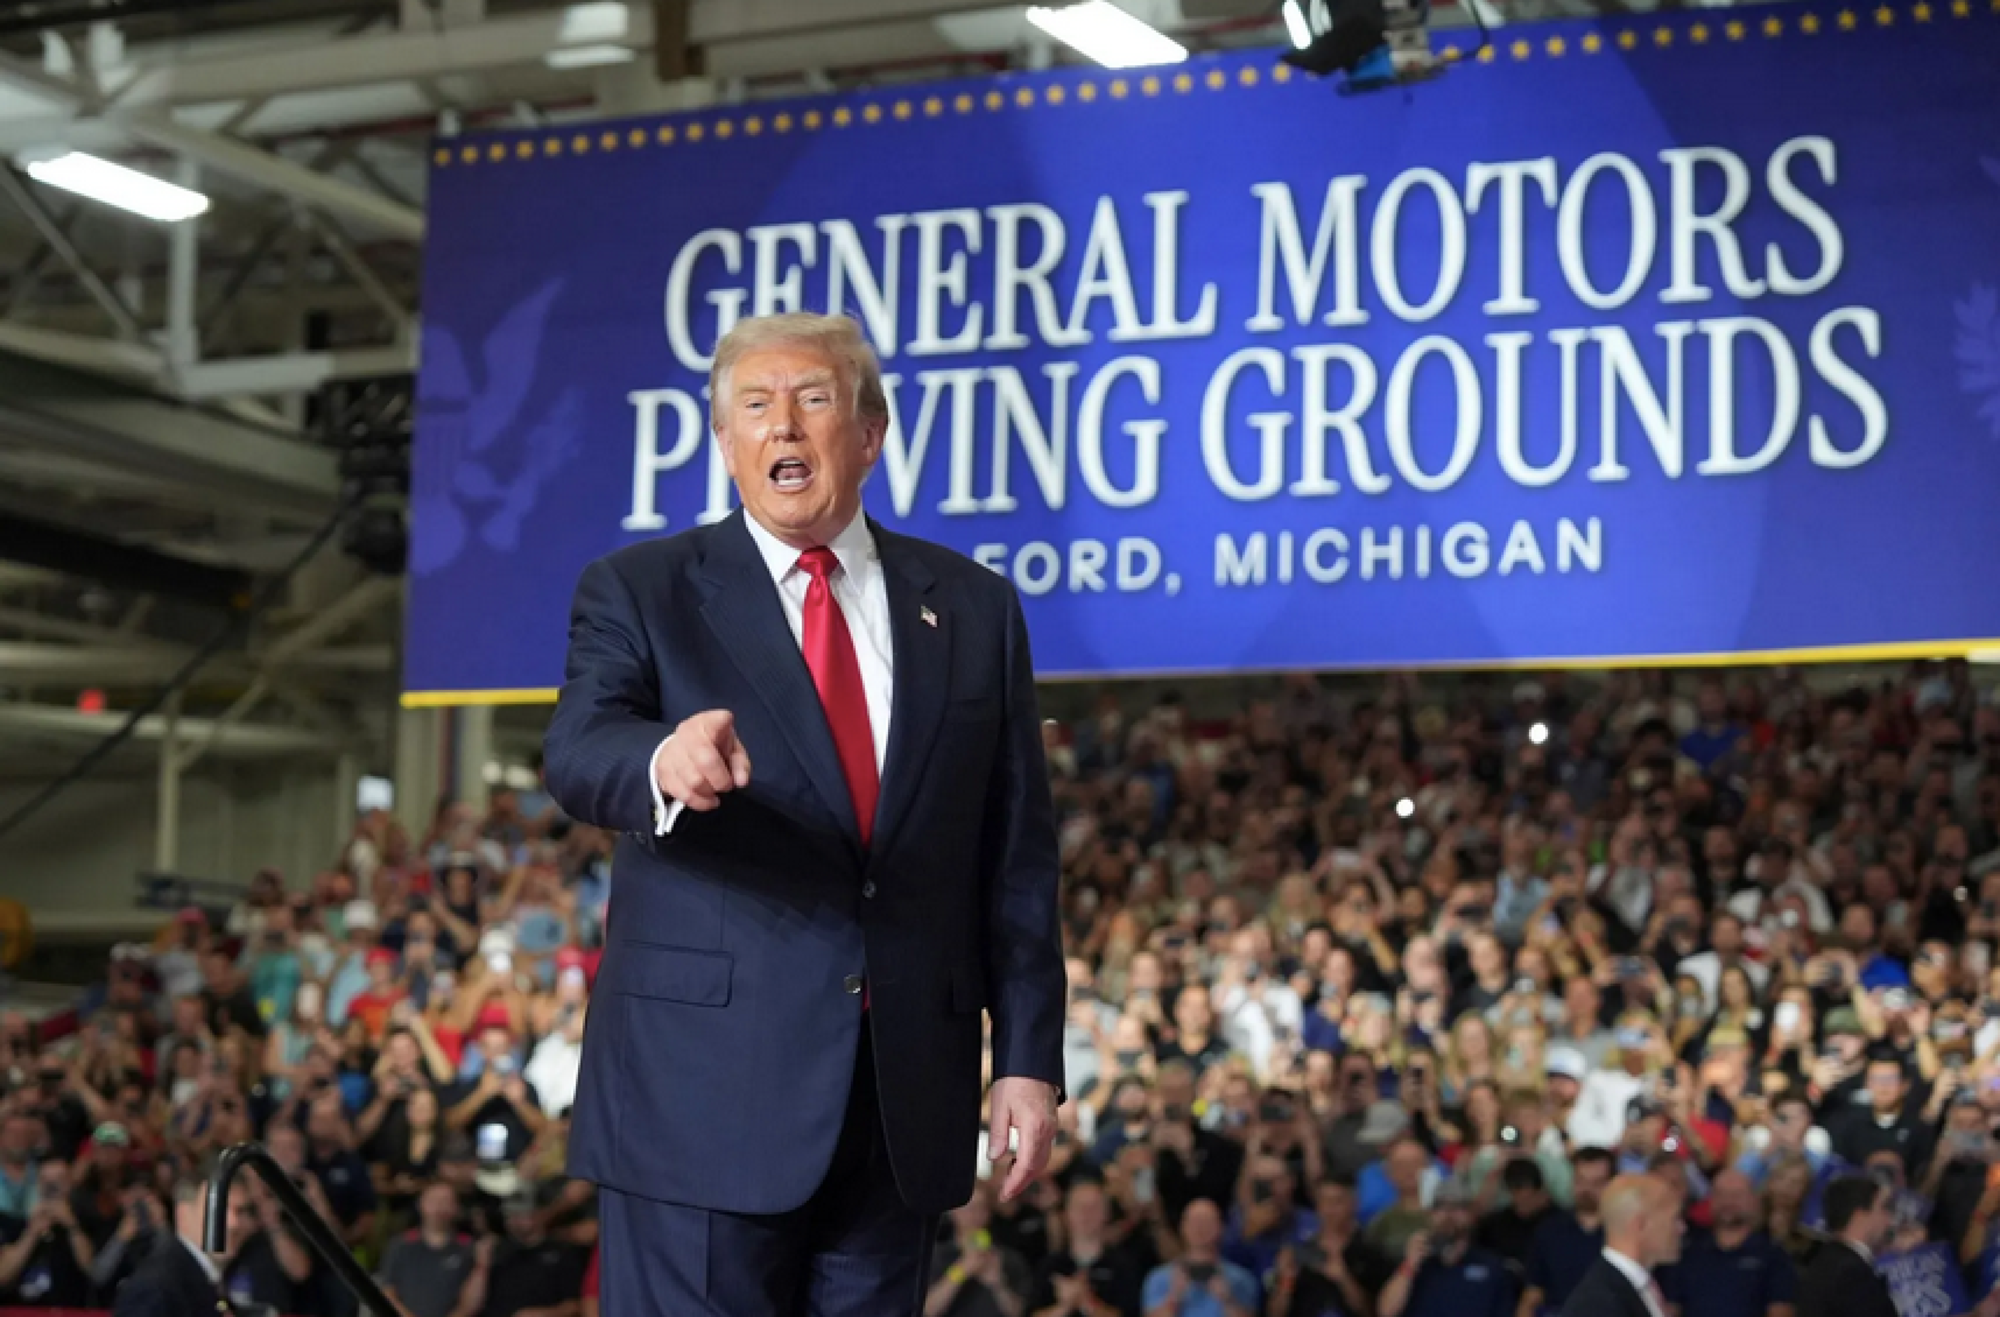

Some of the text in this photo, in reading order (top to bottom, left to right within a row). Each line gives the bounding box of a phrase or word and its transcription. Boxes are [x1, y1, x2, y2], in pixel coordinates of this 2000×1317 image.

[664, 136, 1843, 372] GENERAL MOTORS
[620, 306, 1888, 531] PVING GROUNDS
[1213, 516, 1603, 587] MICHIGAN
